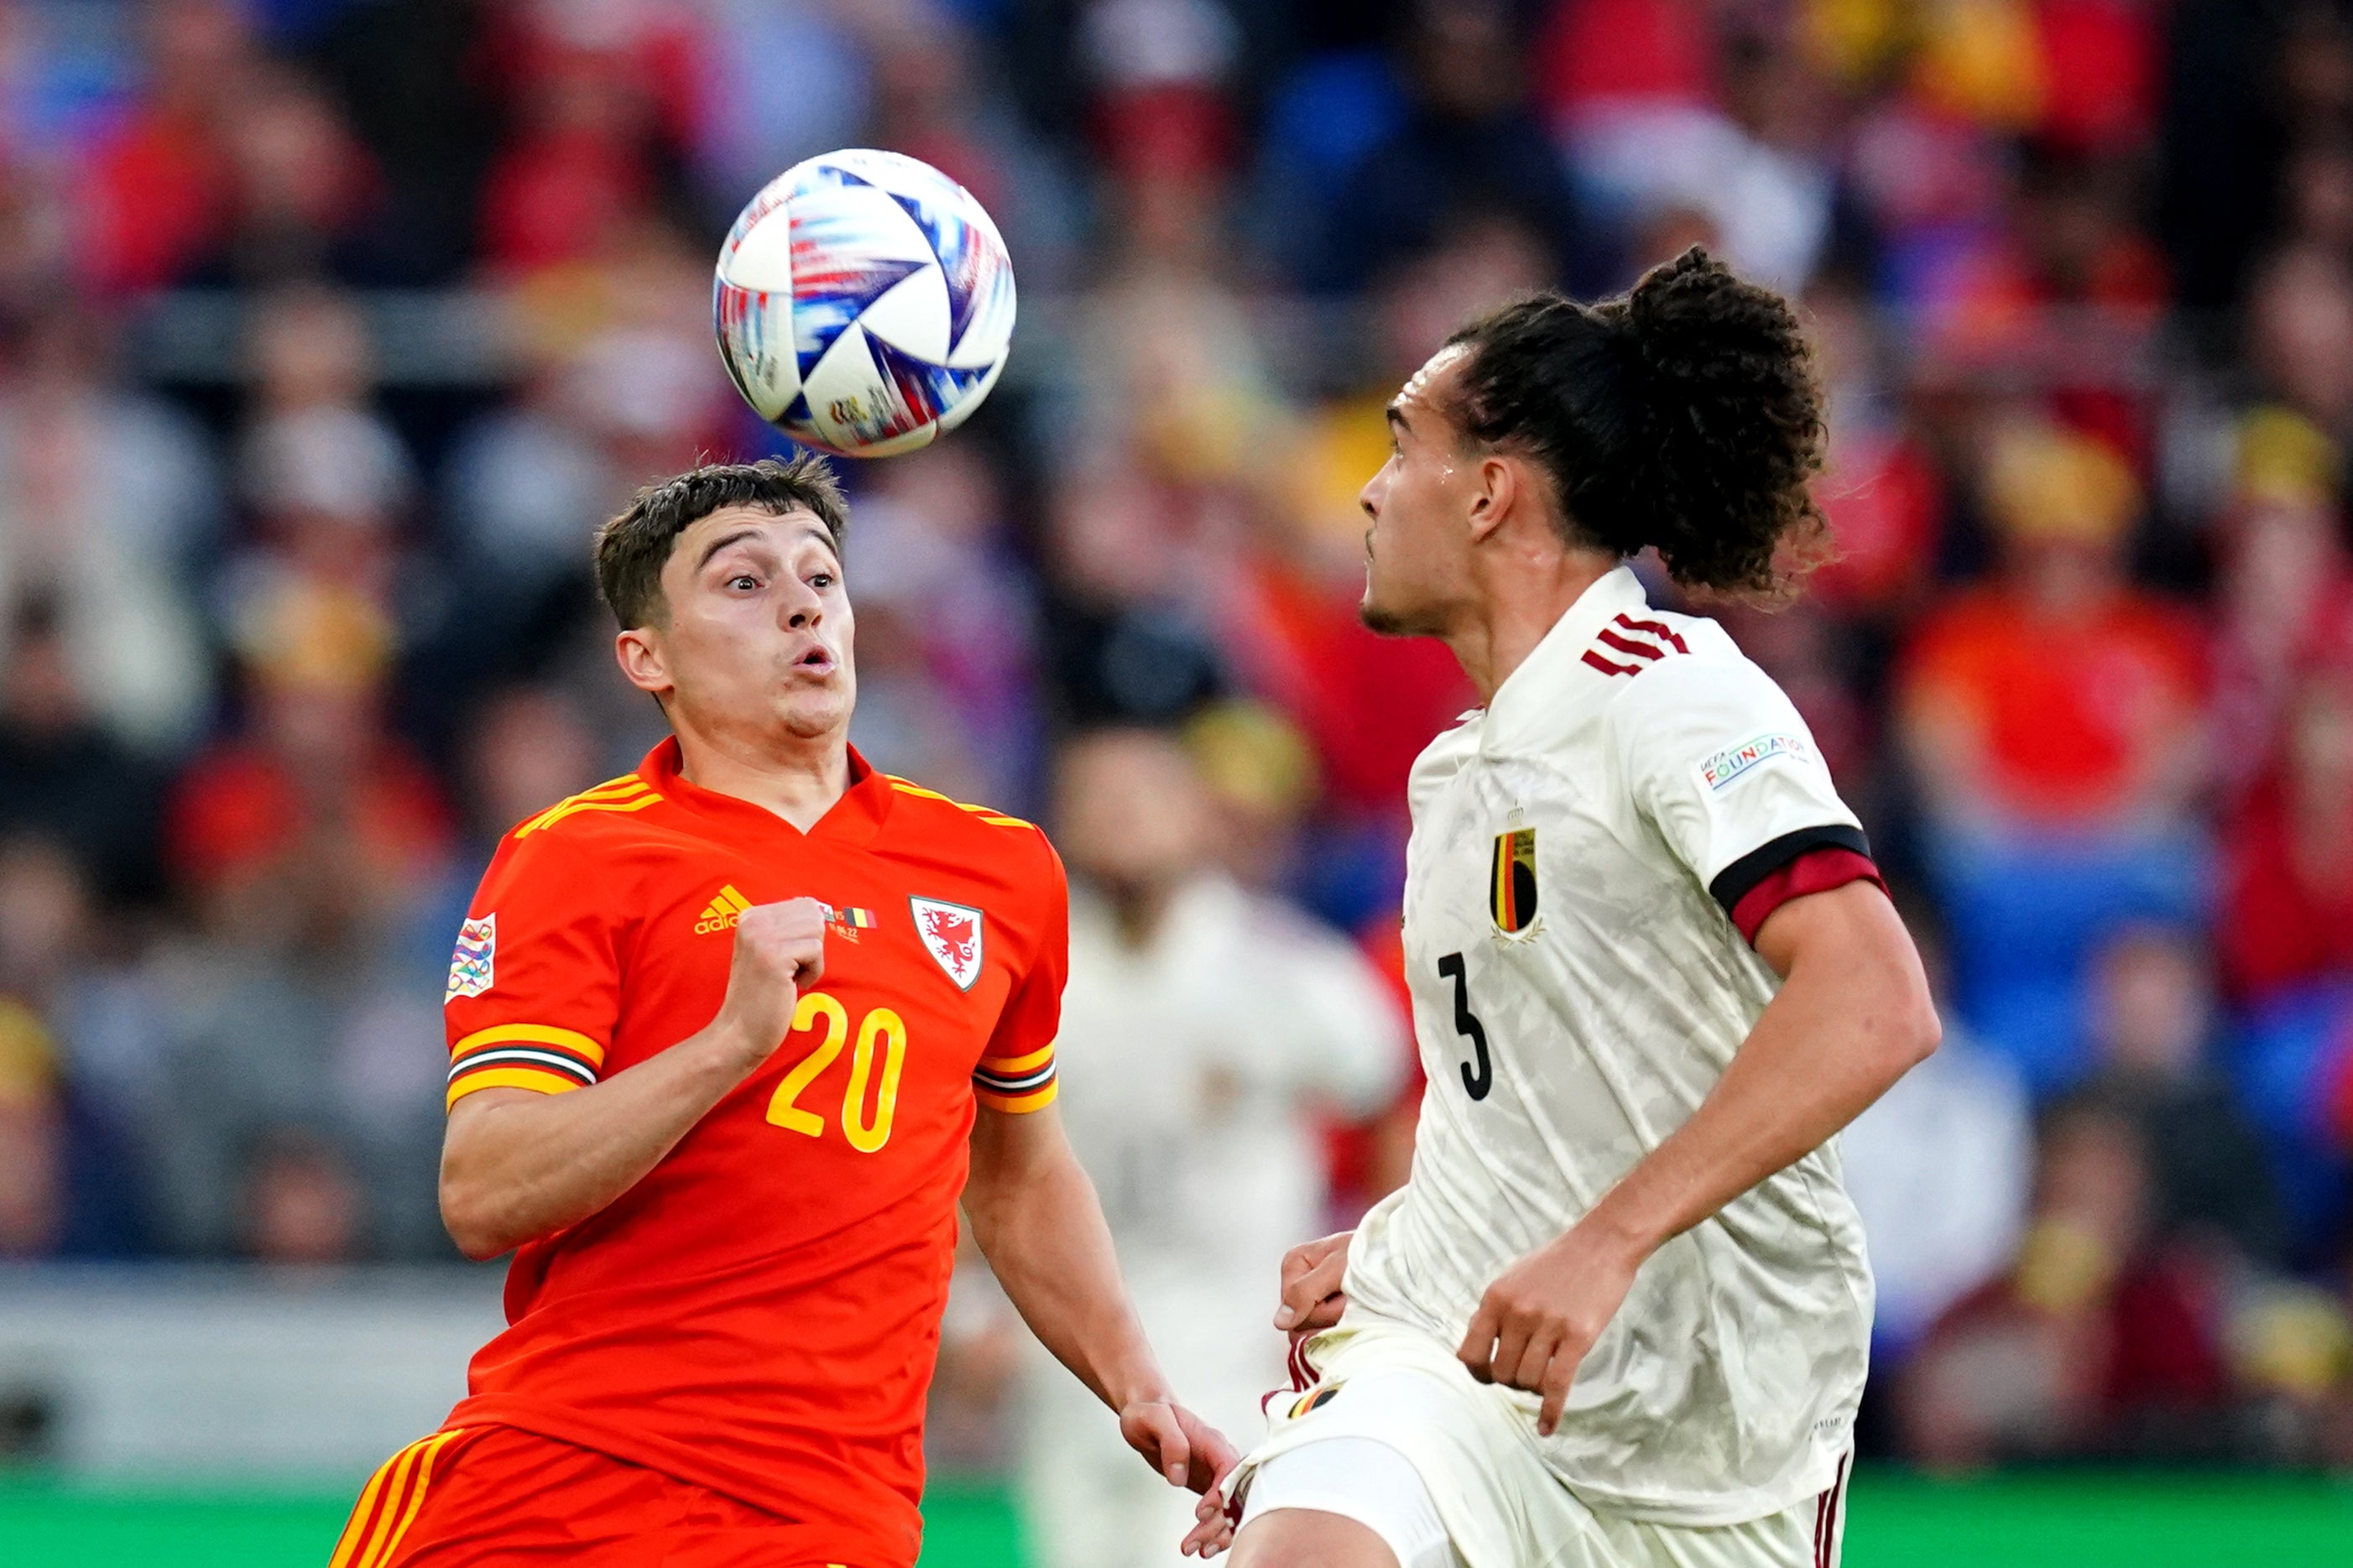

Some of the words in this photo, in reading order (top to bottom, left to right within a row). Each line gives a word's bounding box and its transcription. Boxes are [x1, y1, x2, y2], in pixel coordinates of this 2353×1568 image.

[1701, 751, 1726, 771] UEFA
[765, 992, 907, 1154] 20
[1437, 951, 1493, 1102] 3
